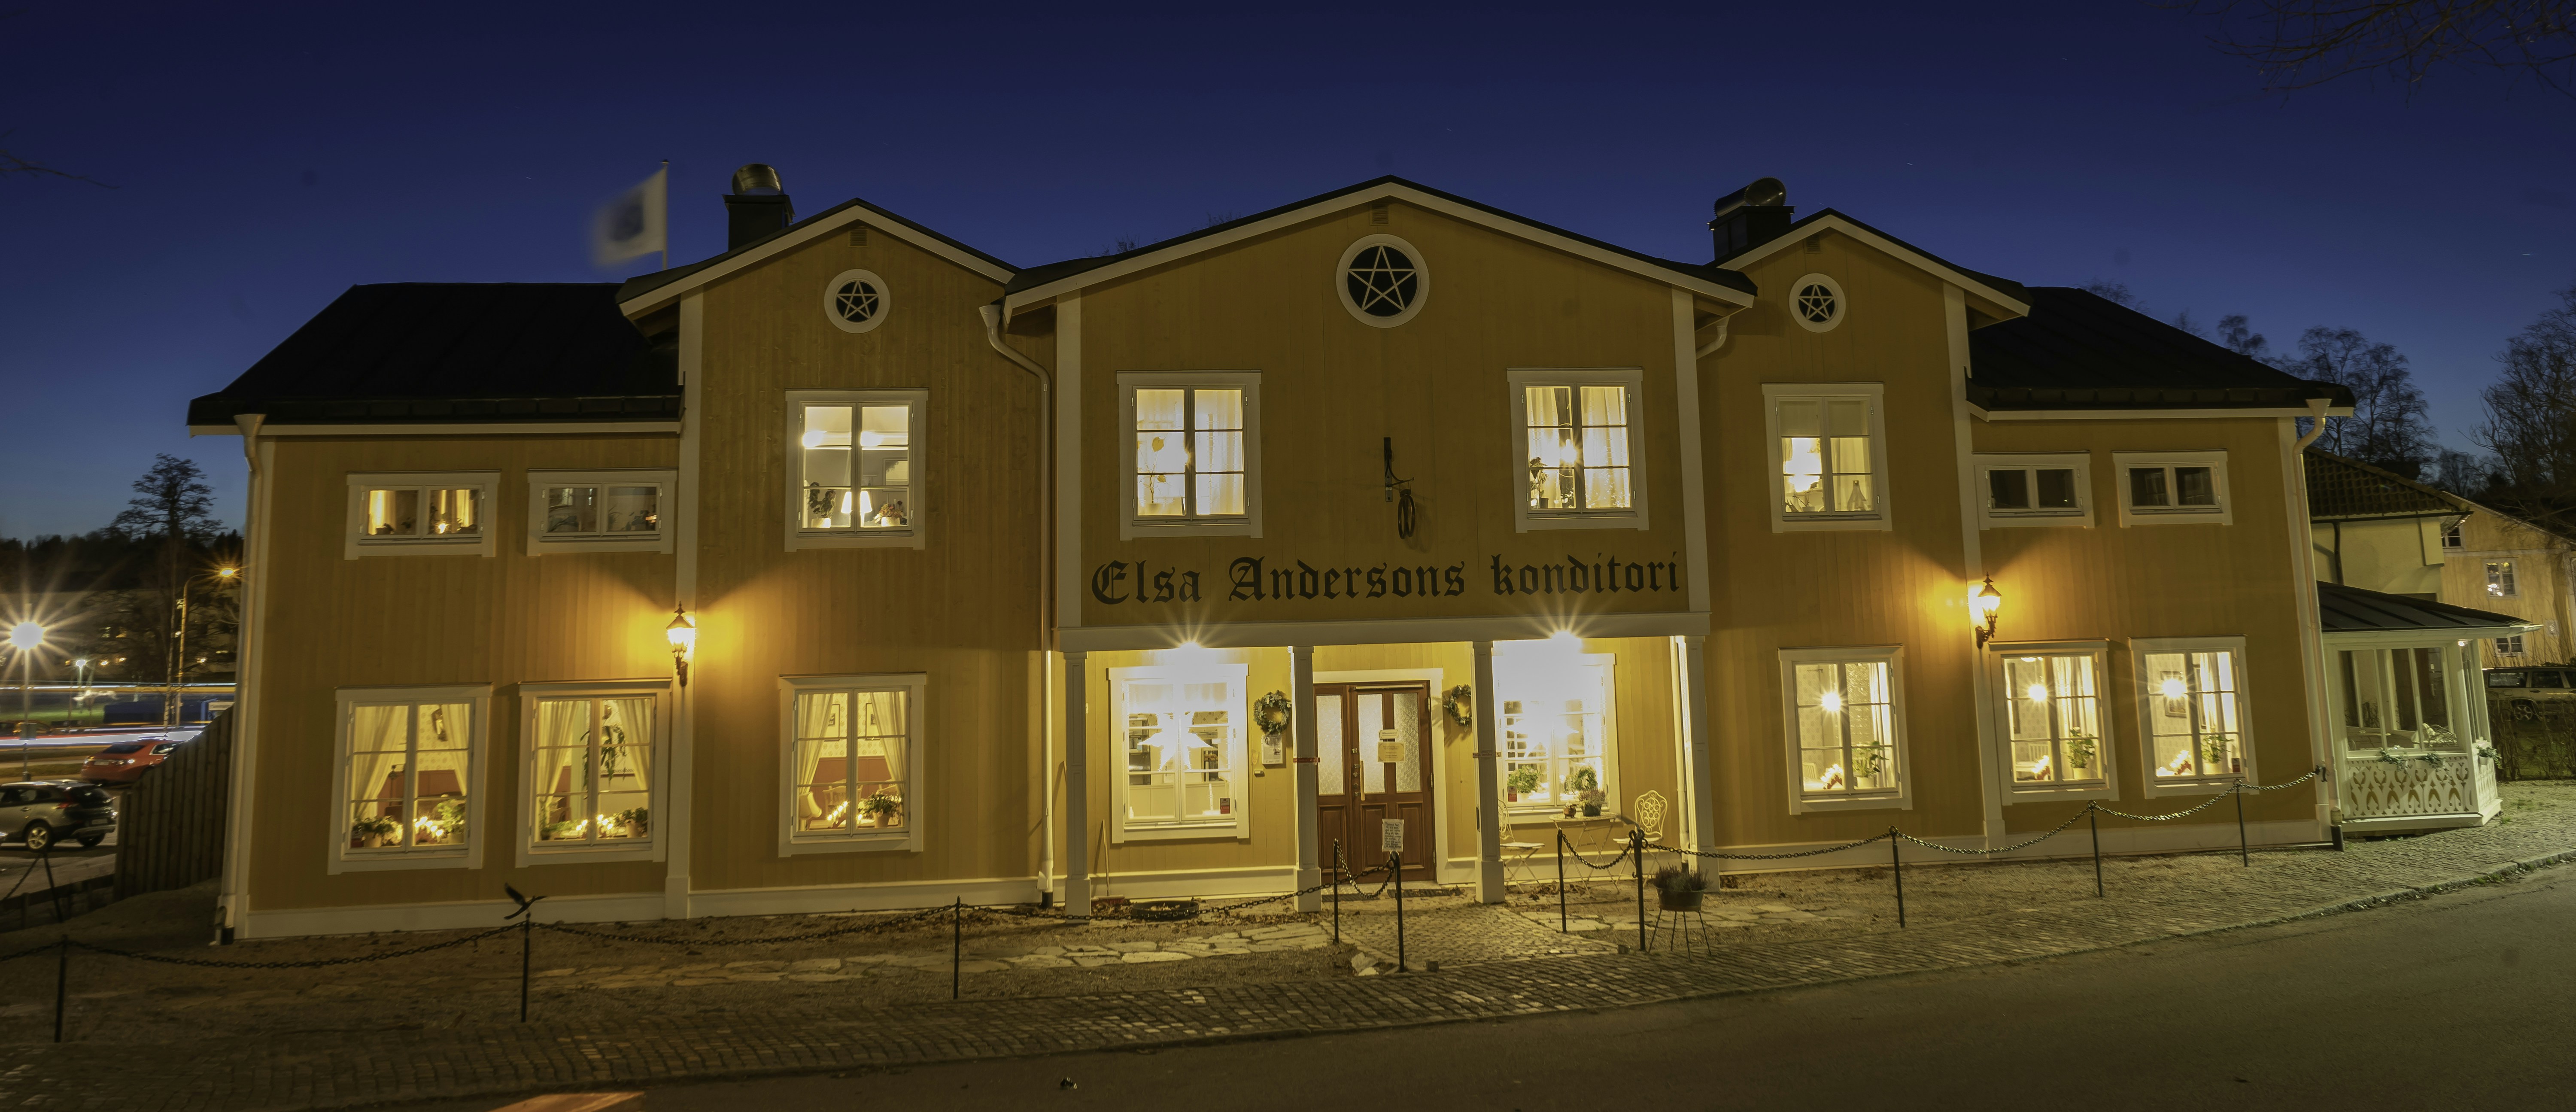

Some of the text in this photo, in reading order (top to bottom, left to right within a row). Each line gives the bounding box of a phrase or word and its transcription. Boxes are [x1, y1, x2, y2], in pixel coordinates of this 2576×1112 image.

[1092, 551, 1680, 605] Elsa Andersons konditori
